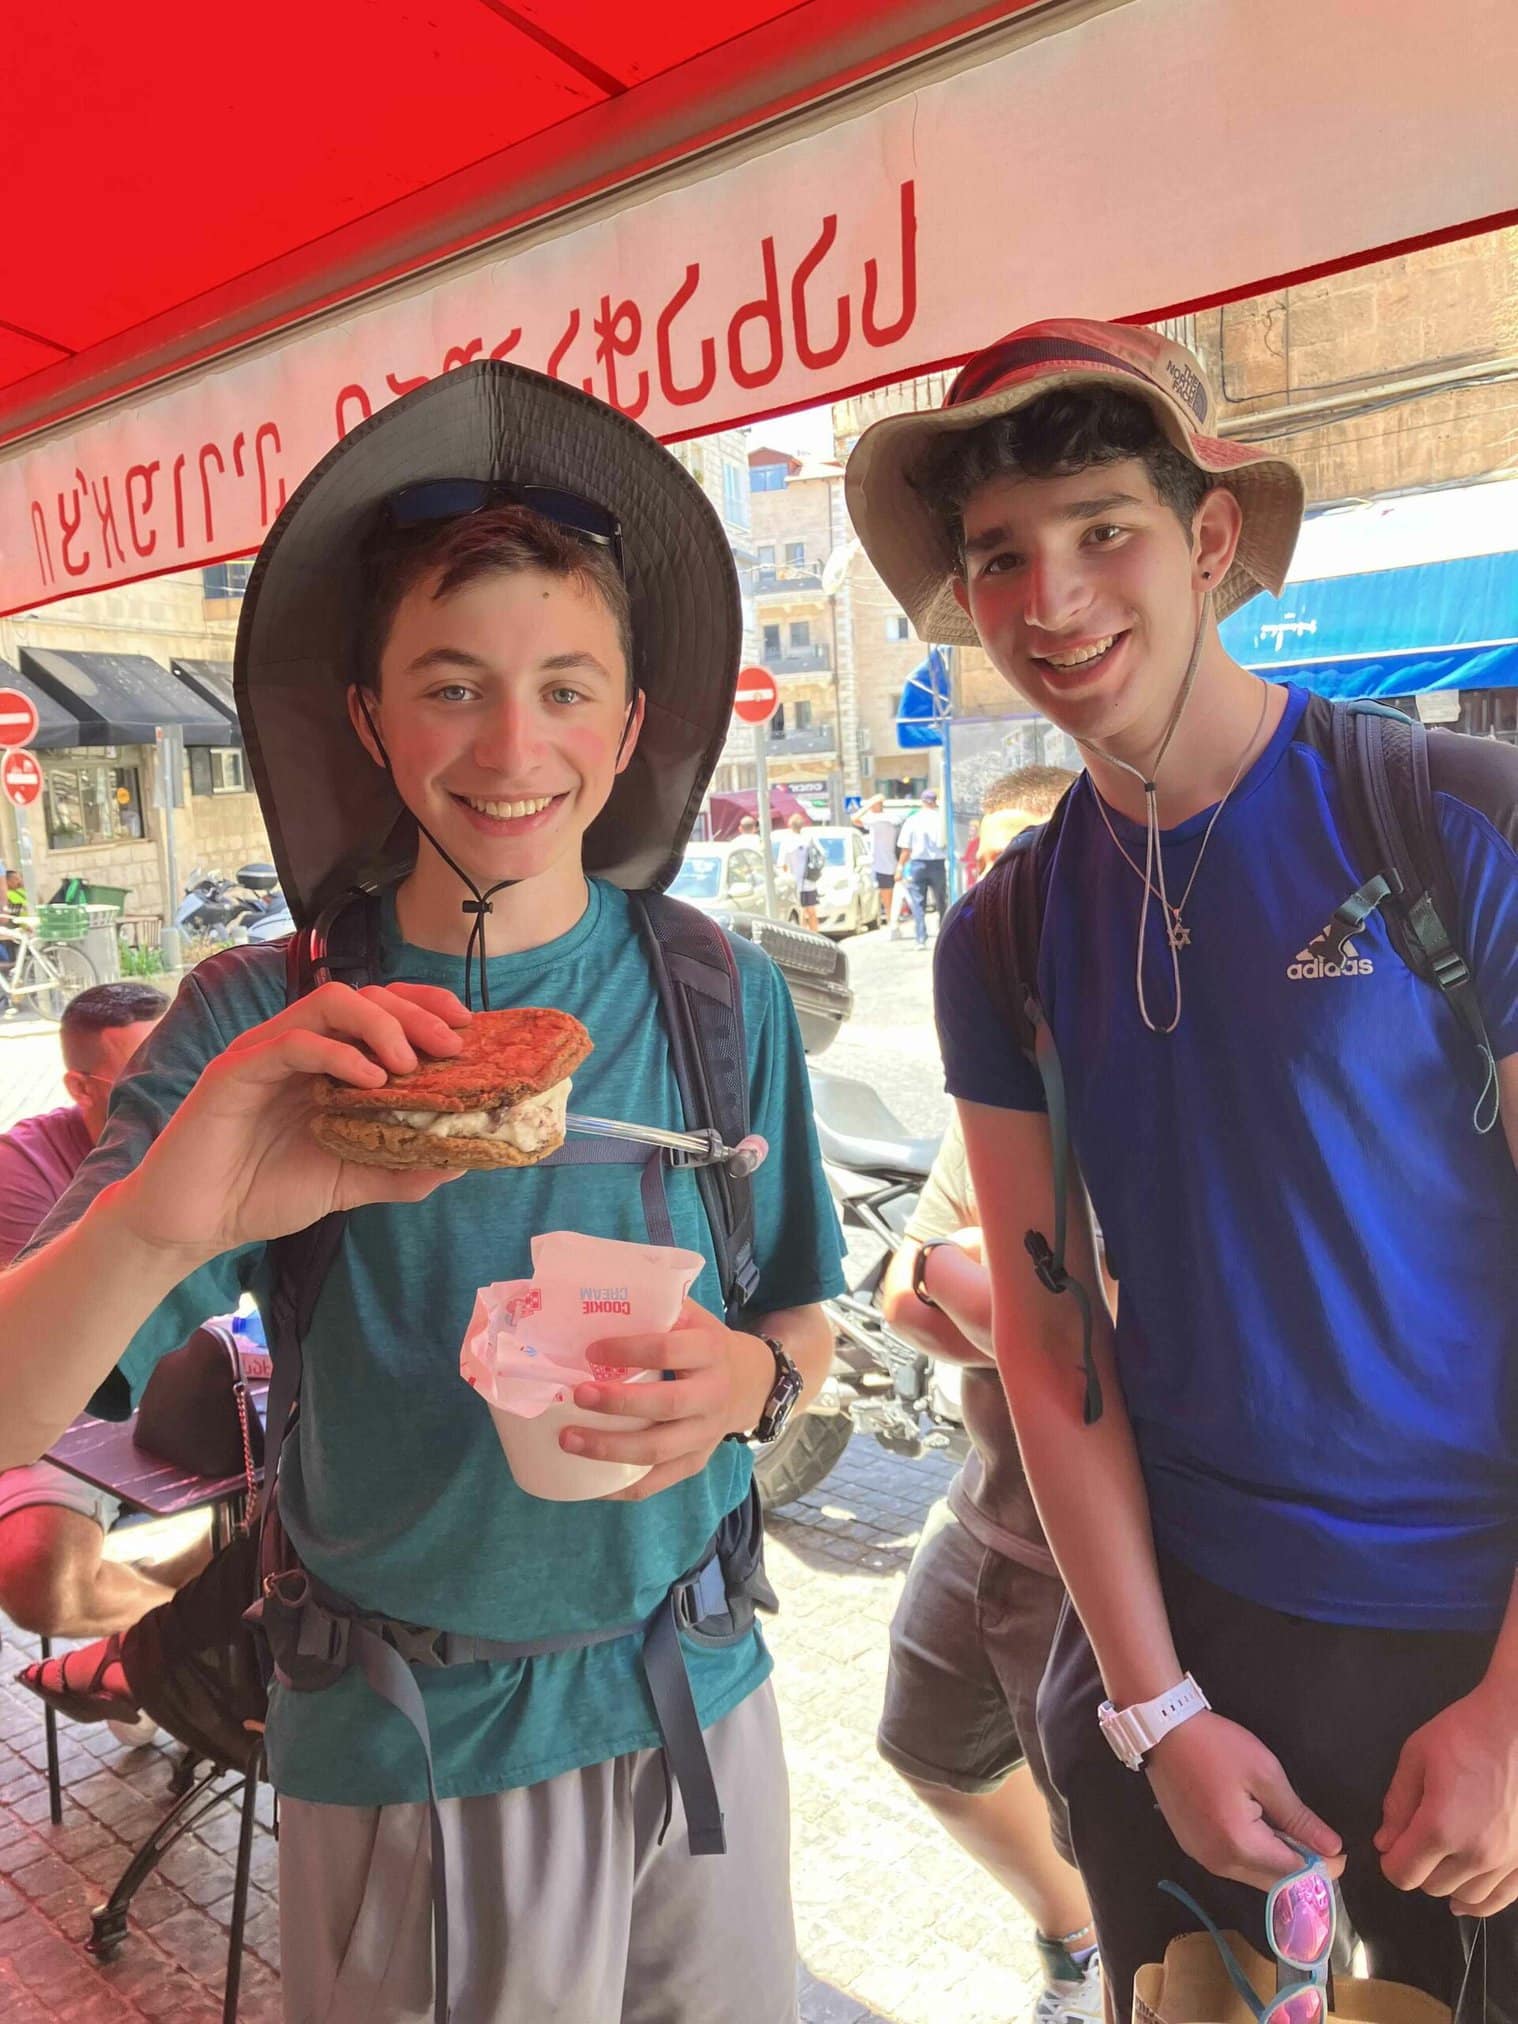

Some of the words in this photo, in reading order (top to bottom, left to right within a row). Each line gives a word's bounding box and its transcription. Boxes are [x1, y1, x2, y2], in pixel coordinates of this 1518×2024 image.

[1166, 359, 1197, 398] NORTH
[1184, 363, 1201, 390] THE
[1172, 379, 1196, 408] FACE
[1286, 956, 1374, 980] adidas
[580, 1287, 629, 1301] CREAM
[583, 1301, 631, 1316] COOKIE
